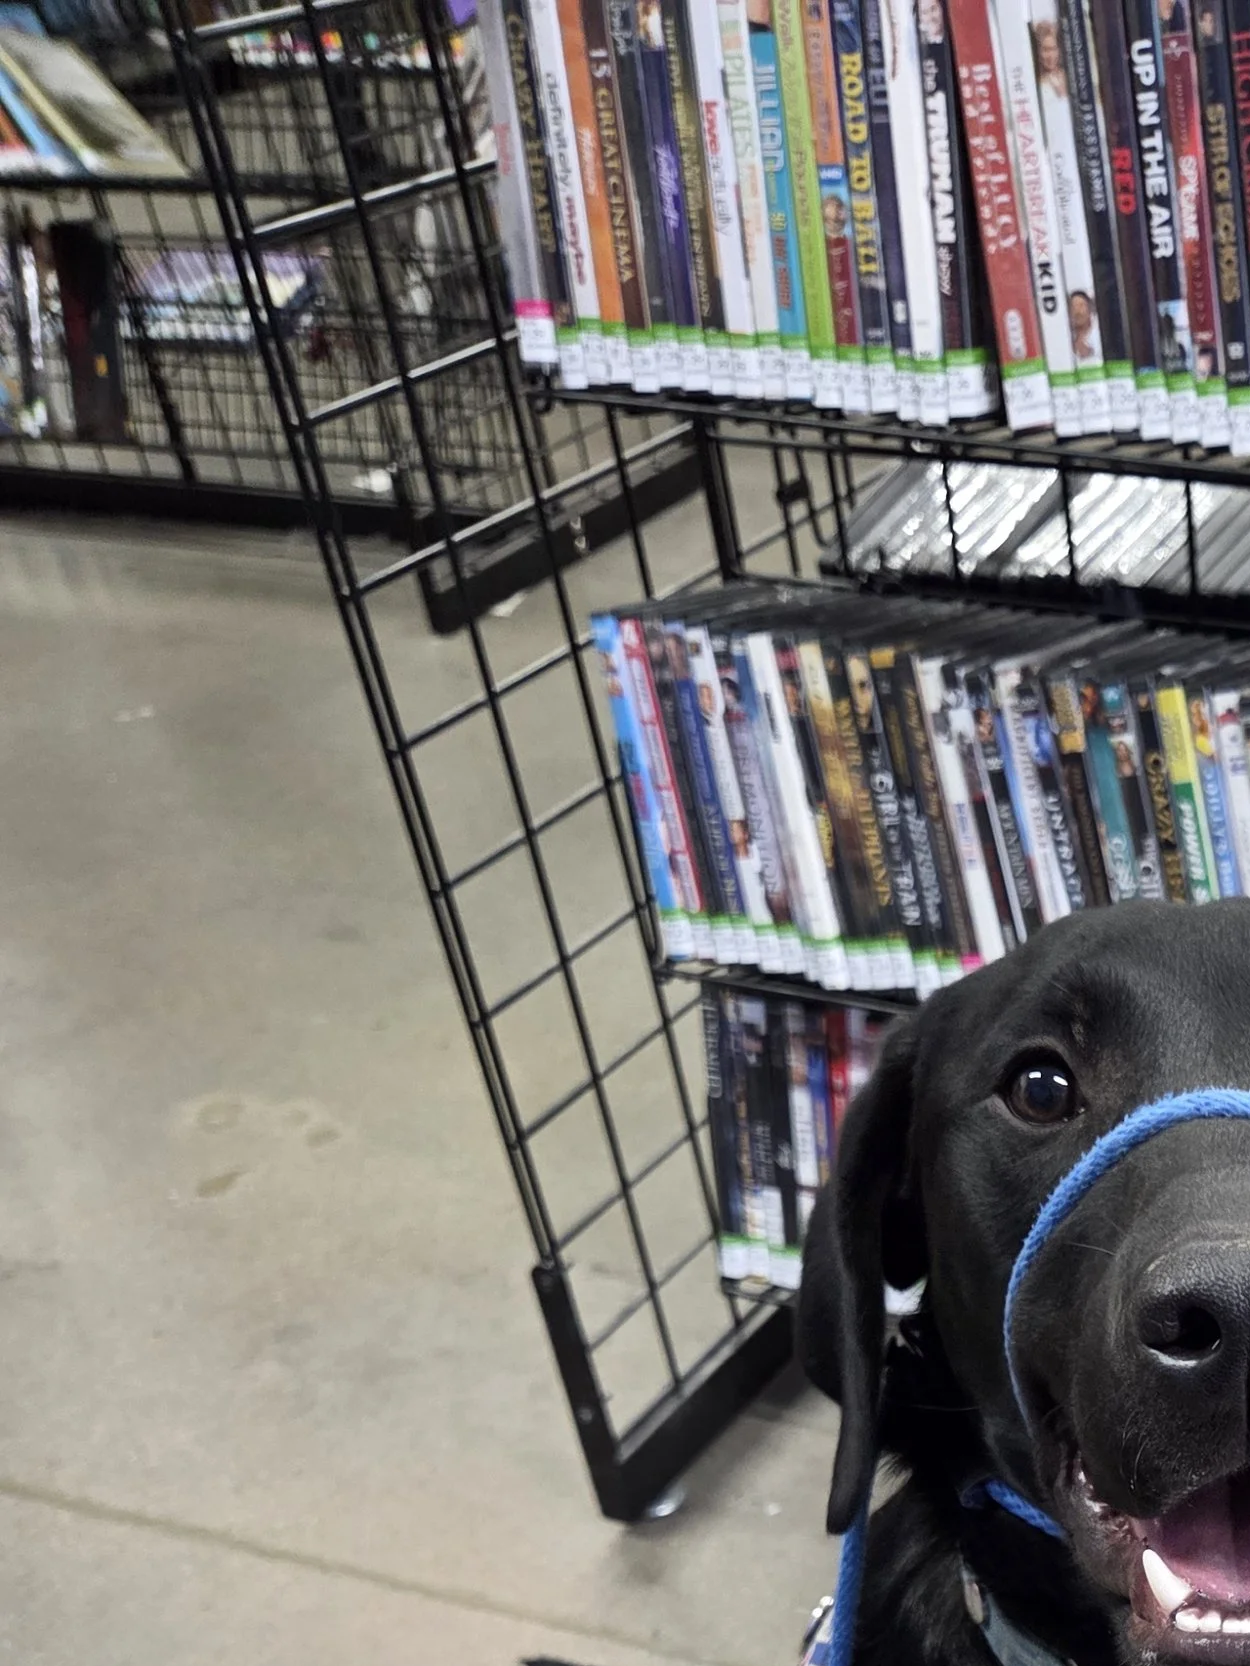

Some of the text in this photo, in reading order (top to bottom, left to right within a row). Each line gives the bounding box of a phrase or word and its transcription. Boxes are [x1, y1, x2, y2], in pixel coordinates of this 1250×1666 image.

[724, 55, 753, 160] PILATES
[753, 63, 786, 172] JILLIAN
[923, 59, 942, 92] the
[971, 63, 997, 124] Best
[590, 48, 636, 284] 15 GREAT CINEMA
[839, 52, 881, 276] ROAD TO BALI
[925, 92, 957, 244] TRUMAN
[1112, 146, 1136, 215] RED
[1130, 39, 1175, 259] UP IN THE AIR
[1177, 155, 1199, 198] SPY
[1205, 103, 1241, 304] STIR OF ECHOES
[1014, 97, 1051, 259] HEARTBREAK
[1036, 259, 1059, 315] KID
[1178, 801, 1206, 881] POWER
